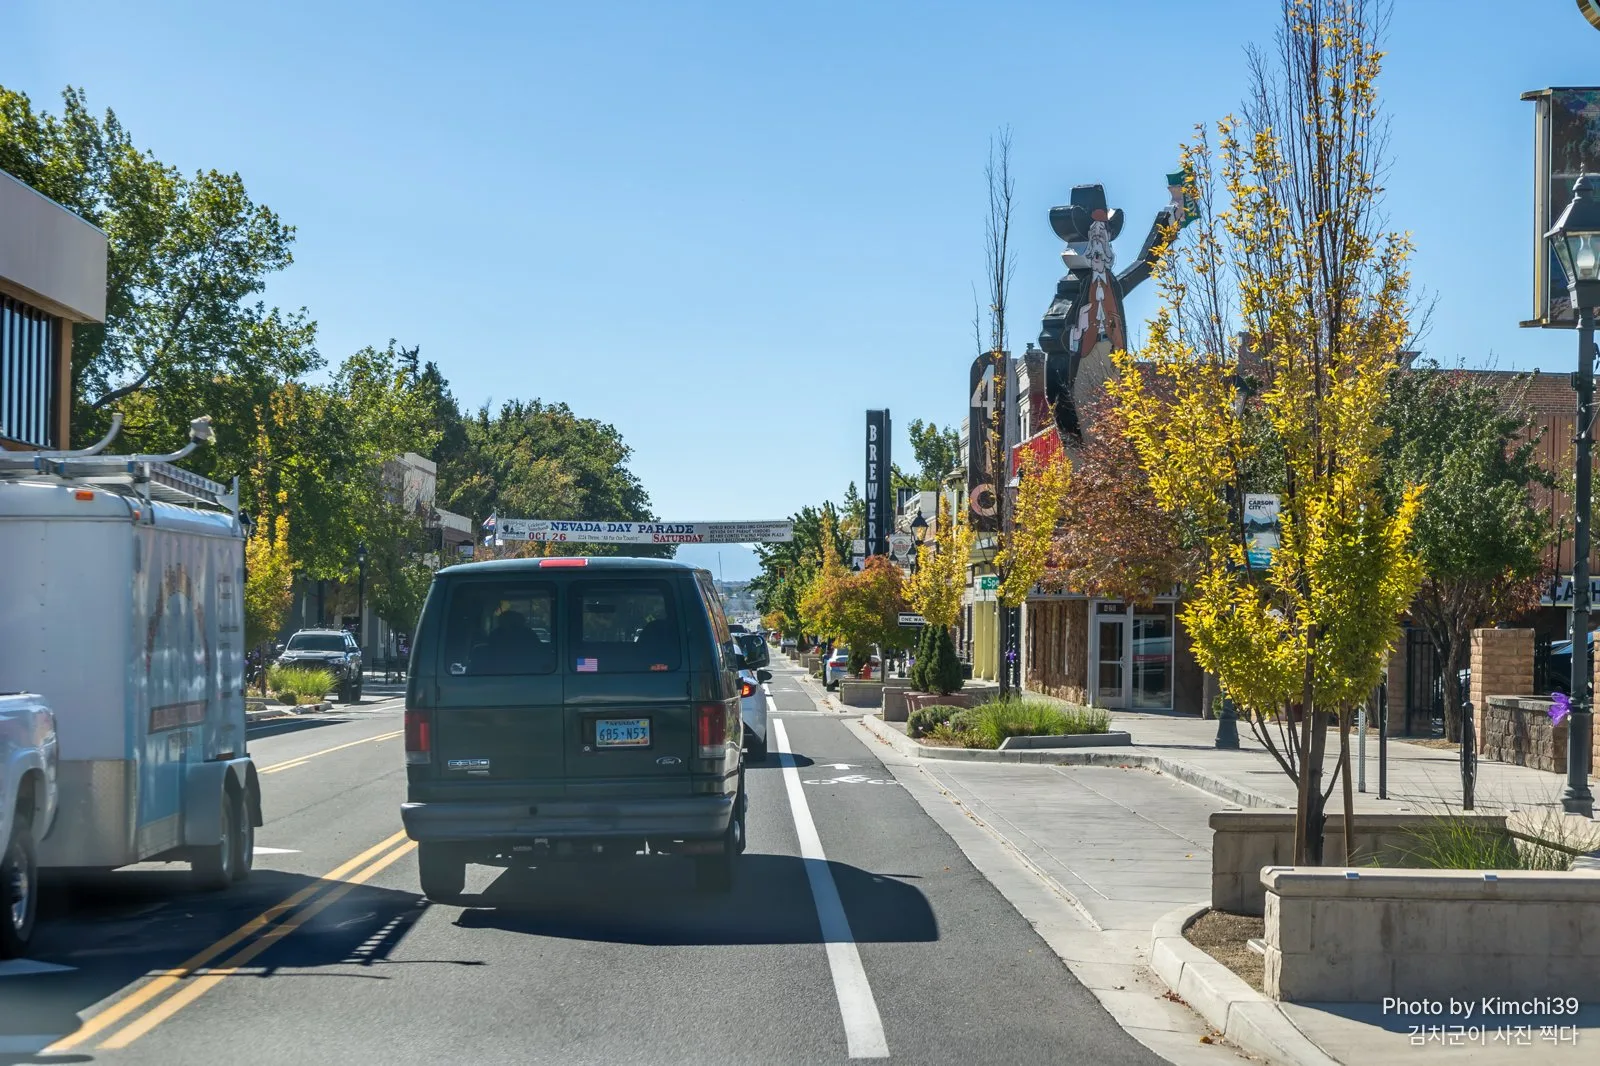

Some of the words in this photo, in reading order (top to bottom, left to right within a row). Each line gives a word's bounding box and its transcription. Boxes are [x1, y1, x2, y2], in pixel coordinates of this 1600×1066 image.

[867, 424, 878, 555] BREWERY
[550, 522, 602, 532] NEVADA
[607, 523, 632, 532] DAY
[638, 524, 694, 534] PARADE
[528, 532, 550, 541] OCT.
[552, 532, 567, 541] 26
[653, 534, 704, 543] SATURDAY
[987, 578, 1000, 588] Spe
